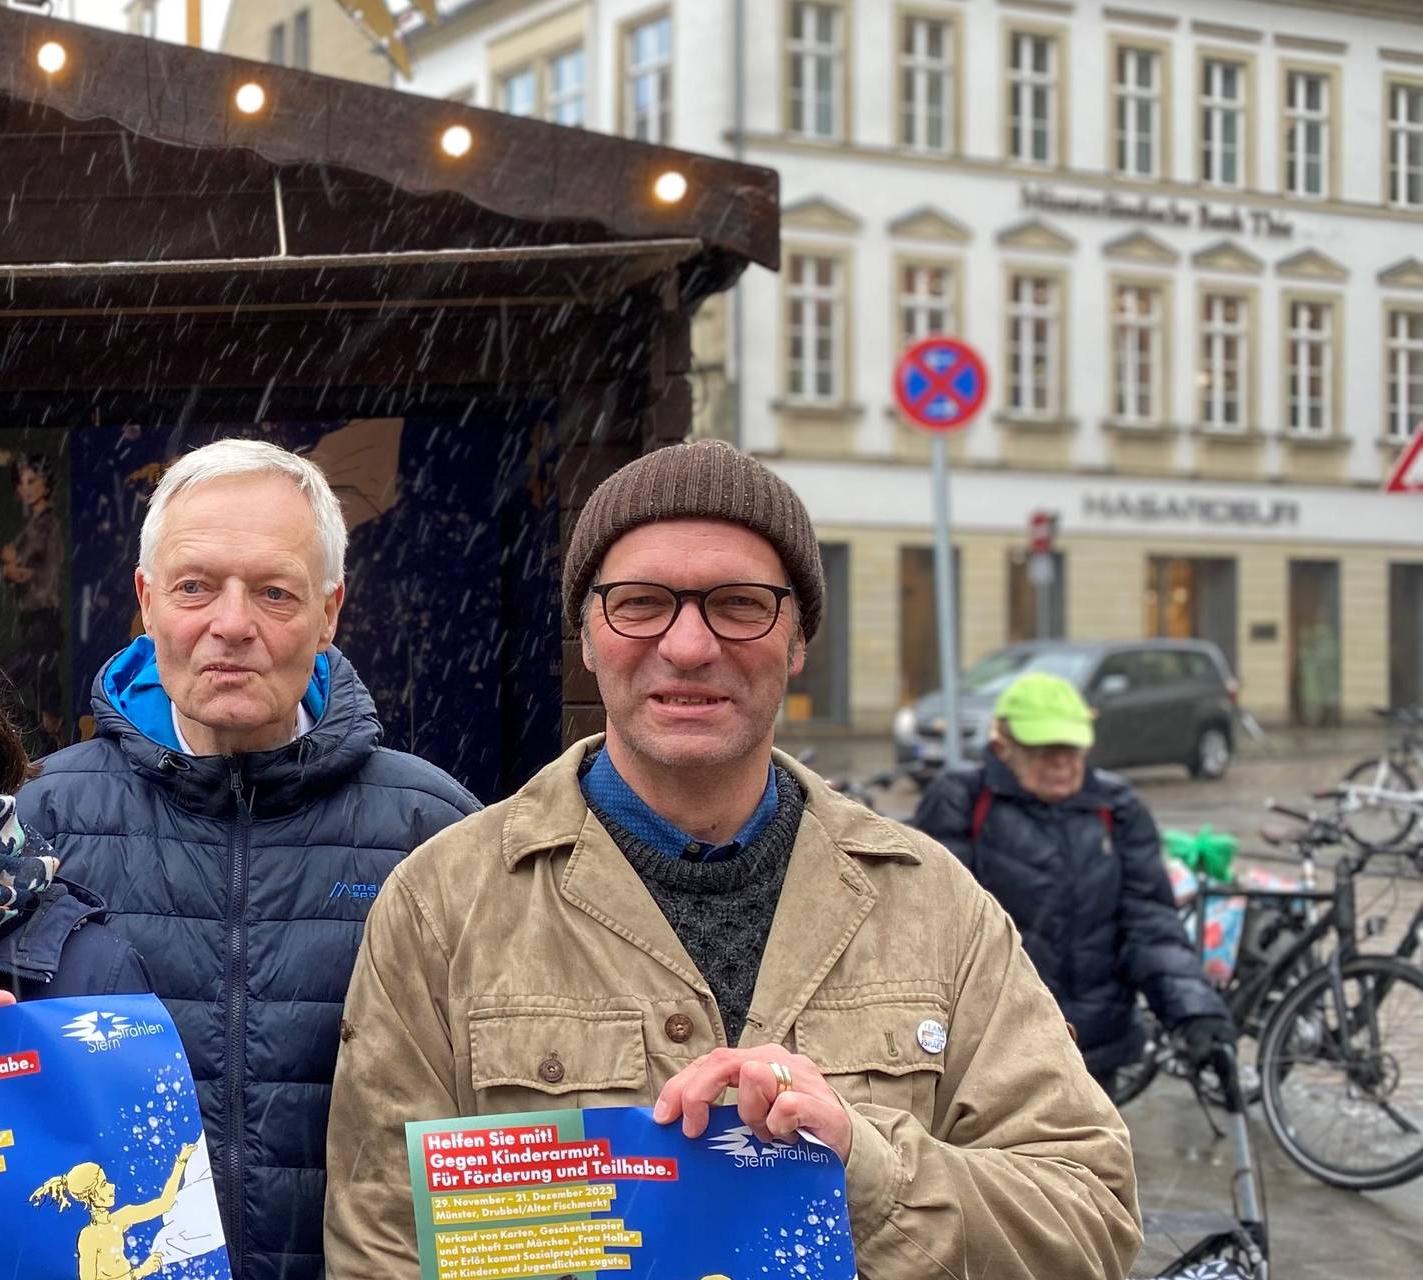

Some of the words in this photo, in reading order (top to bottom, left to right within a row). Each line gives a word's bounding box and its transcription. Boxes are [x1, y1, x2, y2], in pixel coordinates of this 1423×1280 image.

[87, 1039, 121, 1054] Stern
[427, 1133, 485, 1150] Helfen
[489, 1130, 515, 1146] Sie
[520, 1128, 553, 1145] mit!
[430, 1153, 488, 1171] Gegen
[492, 1144, 605, 1165] Kinderarmut.
[735, 1154, 774, 1168] Stern
[432, 1172, 459, 1187] Für
[464, 1168, 552, 1185] Förderung
[556, 1161, 588, 1177] und
[592, 1158, 672, 1176] Teilhabe.
[434, 1199, 450, 1208] 29.
[454, 1195, 505, 1207] November
[515, 1193, 530, 1202] 21.
[532, 1189, 583, 1201] Dezember
[585, 1186, 613, 1196] 2023
[436, 1211, 479, 1220] Münster,
[482, 1203, 551, 1217] Drubbel/Alter
[553, 1198, 608, 1211] Fischmarkt
[437, 1231, 478, 1244] Verkauf
[479, 1232, 498, 1240] von
[500, 1229, 537, 1239] Karten,
[540, 1221, 621, 1236] Geschenkpapier
[439, 1247, 458, 1255] und
[460, 1243, 501, 1254] Textheft
[503, 1242, 524, 1250] zum
[526, 1237, 570, 1248] Märchen
[441, 1259, 458, 1268] Der
[461, 1256, 485, 1266] Erlös
[487, 1253, 521, 1263] kommt
[523, 1246, 601, 1261] Sozialprojekten
[441, 1271, 457, 1279] mit
[460, 1267, 499, 1278] Kindern
[501, 1264, 520, 1274] und
[523, 1259, 587, 1273] Jugendlichen
[589, 1257, 628, 1267] zugute.
